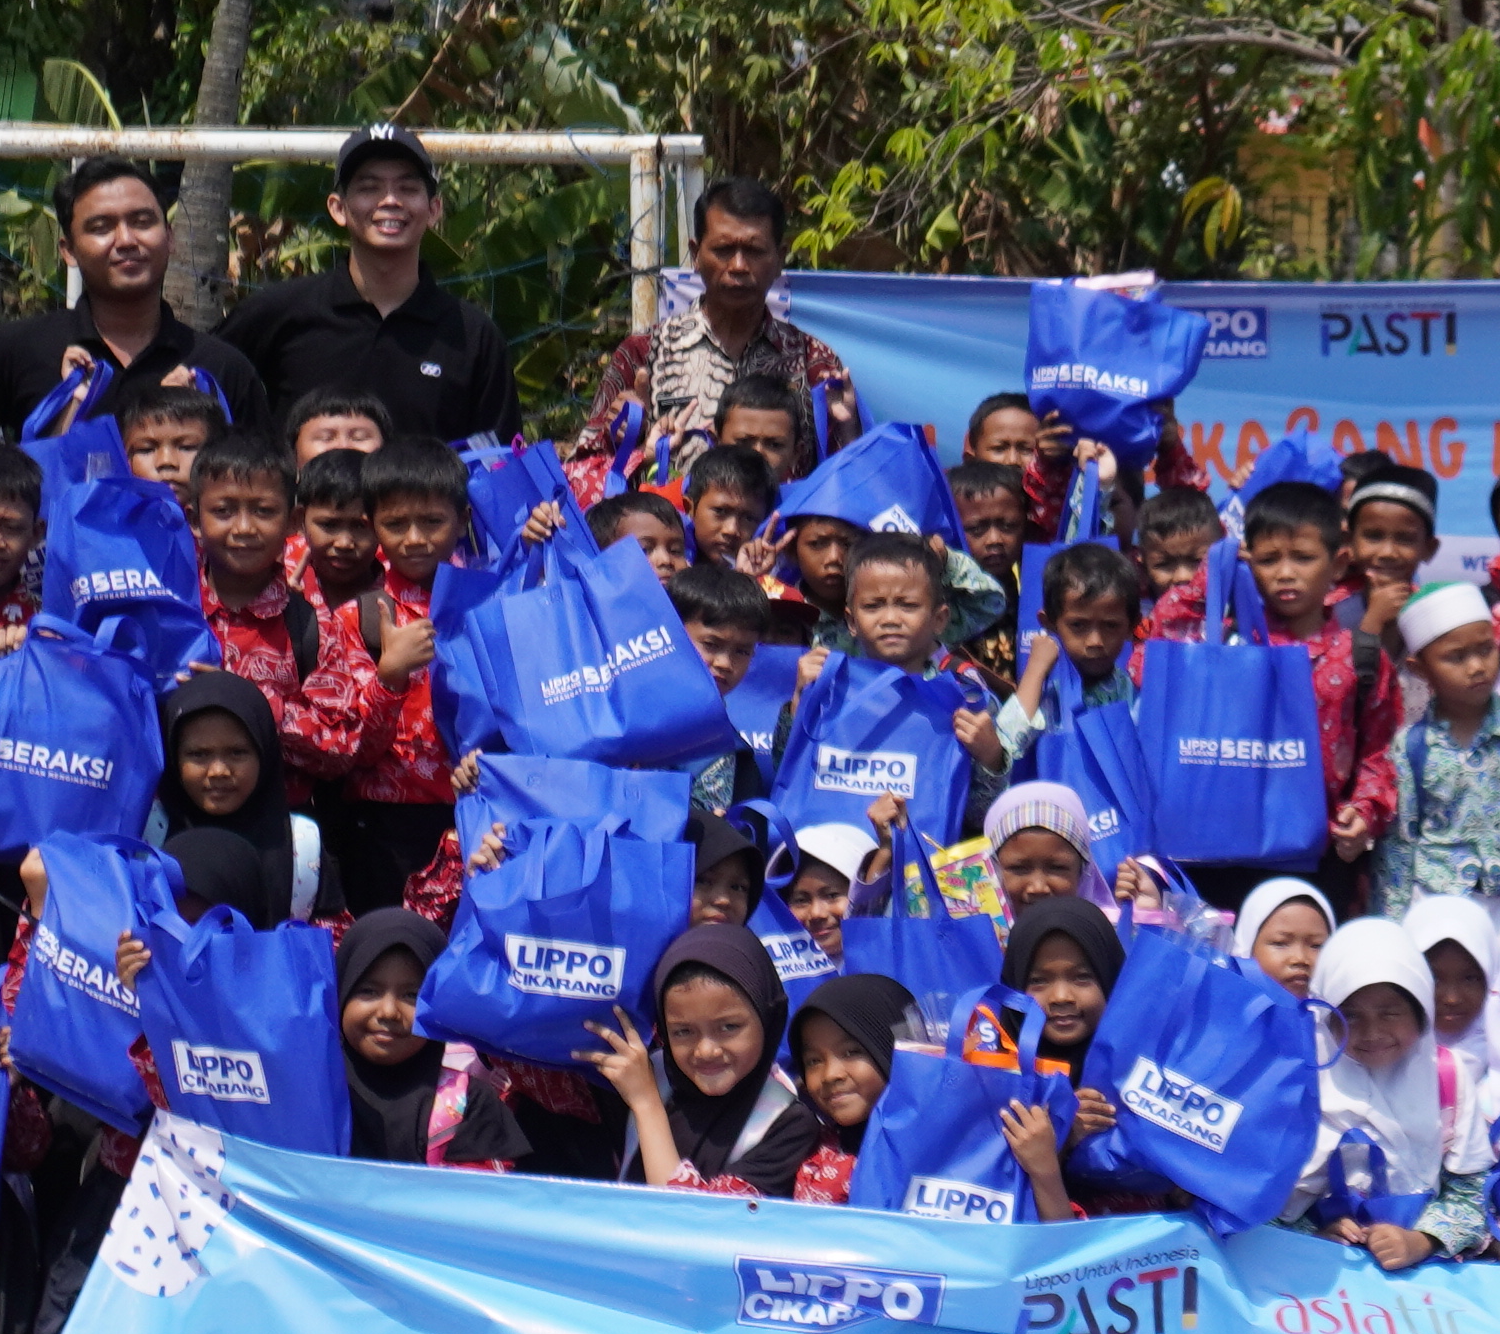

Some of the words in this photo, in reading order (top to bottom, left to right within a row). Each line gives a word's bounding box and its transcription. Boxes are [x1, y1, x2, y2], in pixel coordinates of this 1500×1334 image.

[1059, 363, 1149, 395] BERAKSI
[91, 568, 163, 594] BERA
[828, 754, 906, 779] LIPPO
[1220, 738, 1306, 761] BERKSI
[820, 773, 911, 794] CIKARANG
[517, 945, 612, 979] LIPPO
[511, 969, 617, 998] CIKARANG
[1138, 1068, 1226, 1128] LIPPO
[1123, 1089, 1225, 1148] CIKARANG
[917, 1183, 1009, 1224] LIPPO
[1025, 1271, 1072, 1292] Lippo
[1074, 1259, 1124, 1282] Untuk
[1125, 1243, 1200, 1273] Indonesia
[743, 1293, 866, 1327] CIKAR
[755, 1269, 925, 1321] LIPPO
